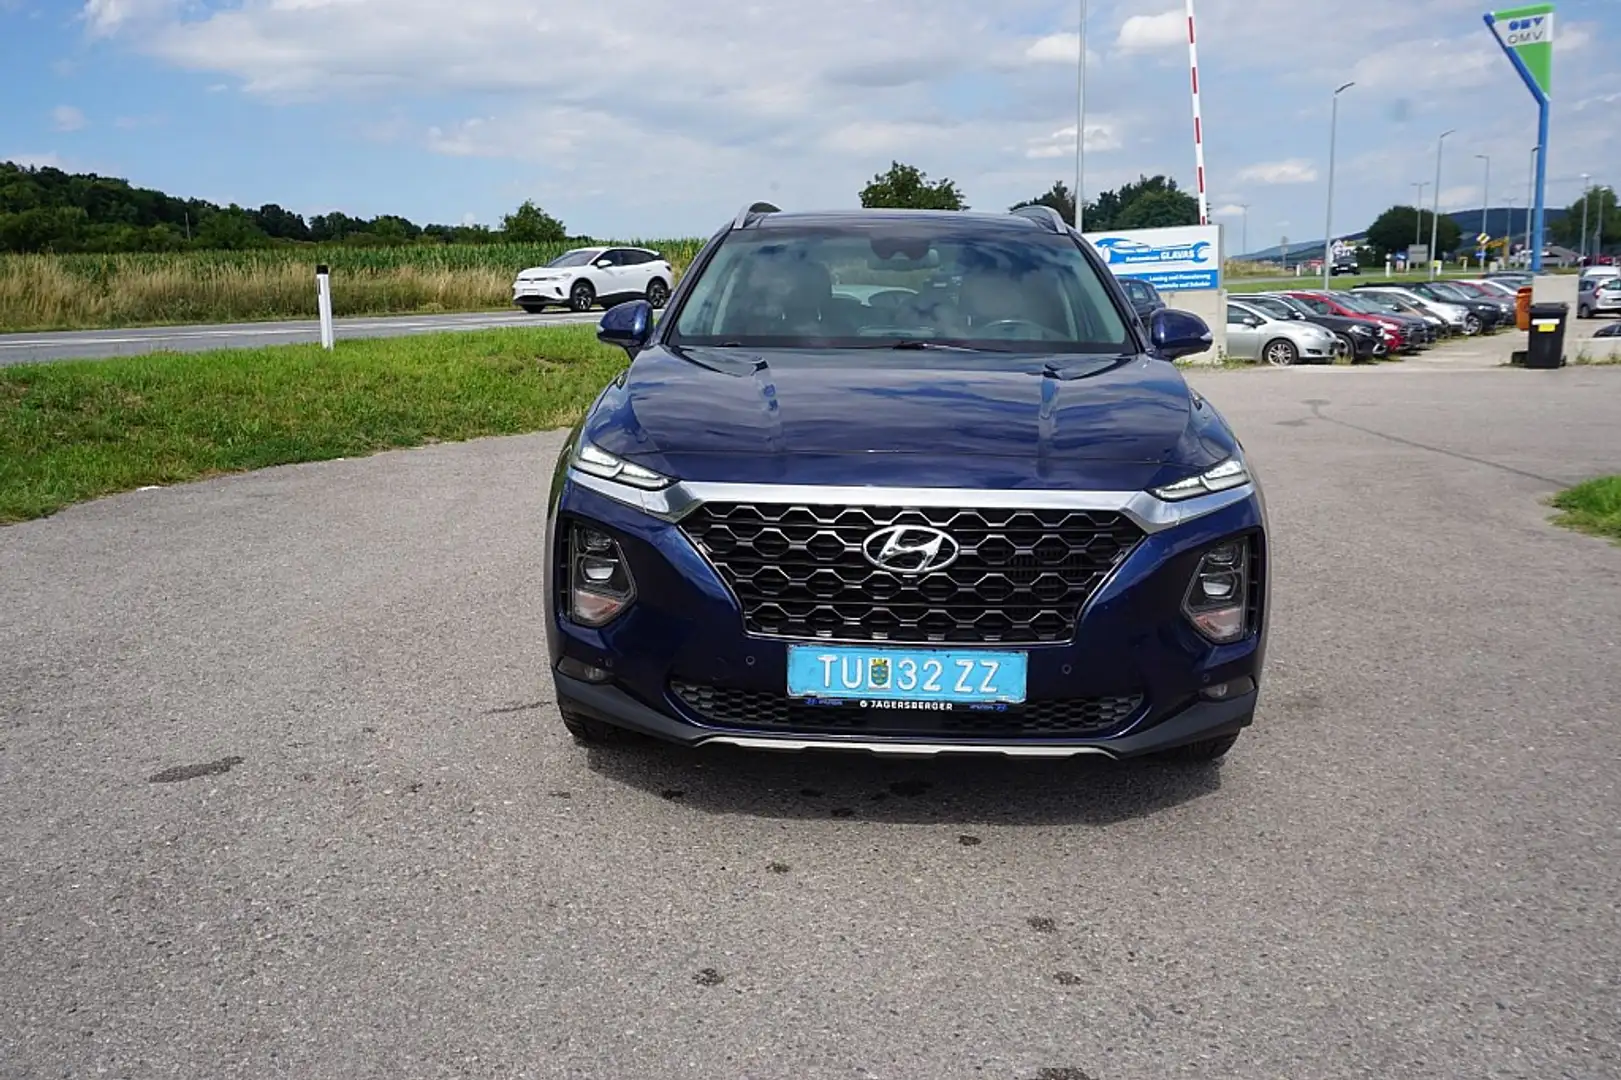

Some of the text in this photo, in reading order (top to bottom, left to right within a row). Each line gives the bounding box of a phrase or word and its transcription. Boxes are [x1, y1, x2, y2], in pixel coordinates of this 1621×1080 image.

[1507, 30, 1543, 44] OMV
[1160, 250, 1194, 260] GLAVAS
[816, 654, 1000, 693] TU 32 ZZ
